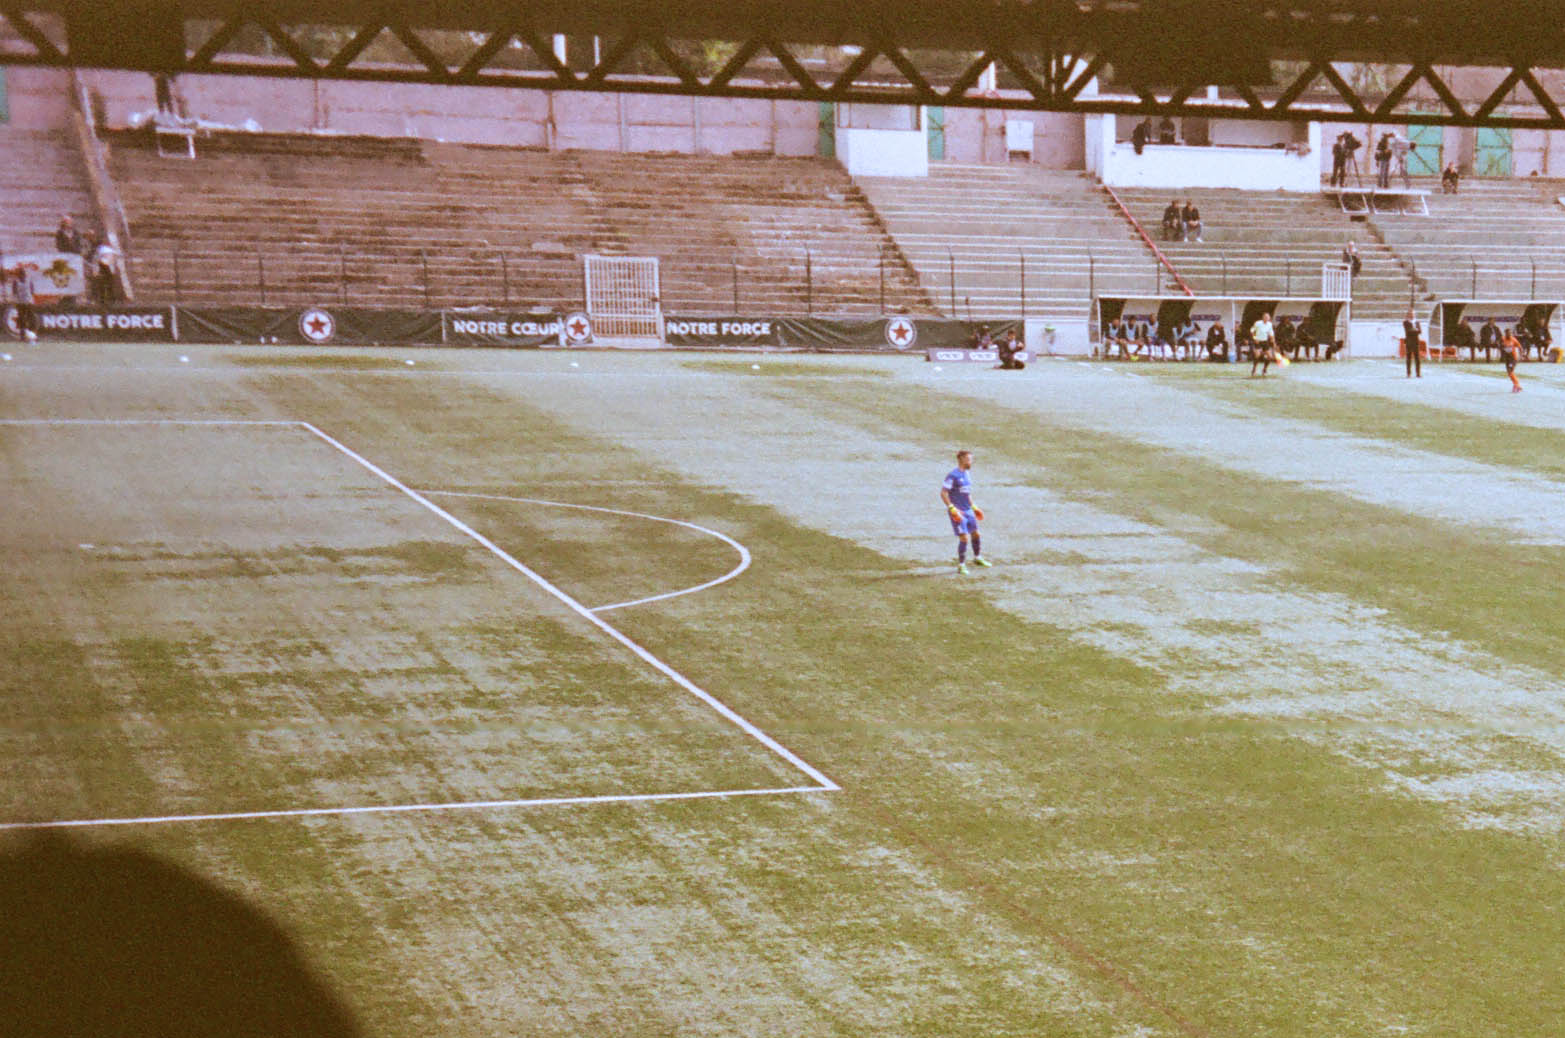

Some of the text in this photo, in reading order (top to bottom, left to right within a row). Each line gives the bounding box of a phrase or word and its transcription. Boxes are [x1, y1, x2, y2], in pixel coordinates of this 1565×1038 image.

[43, 315, 164, 328] NOTRE FORCE
[453, 320, 508, 334] NOTRE
[667, 321, 771, 335] NOTRE FORCE
